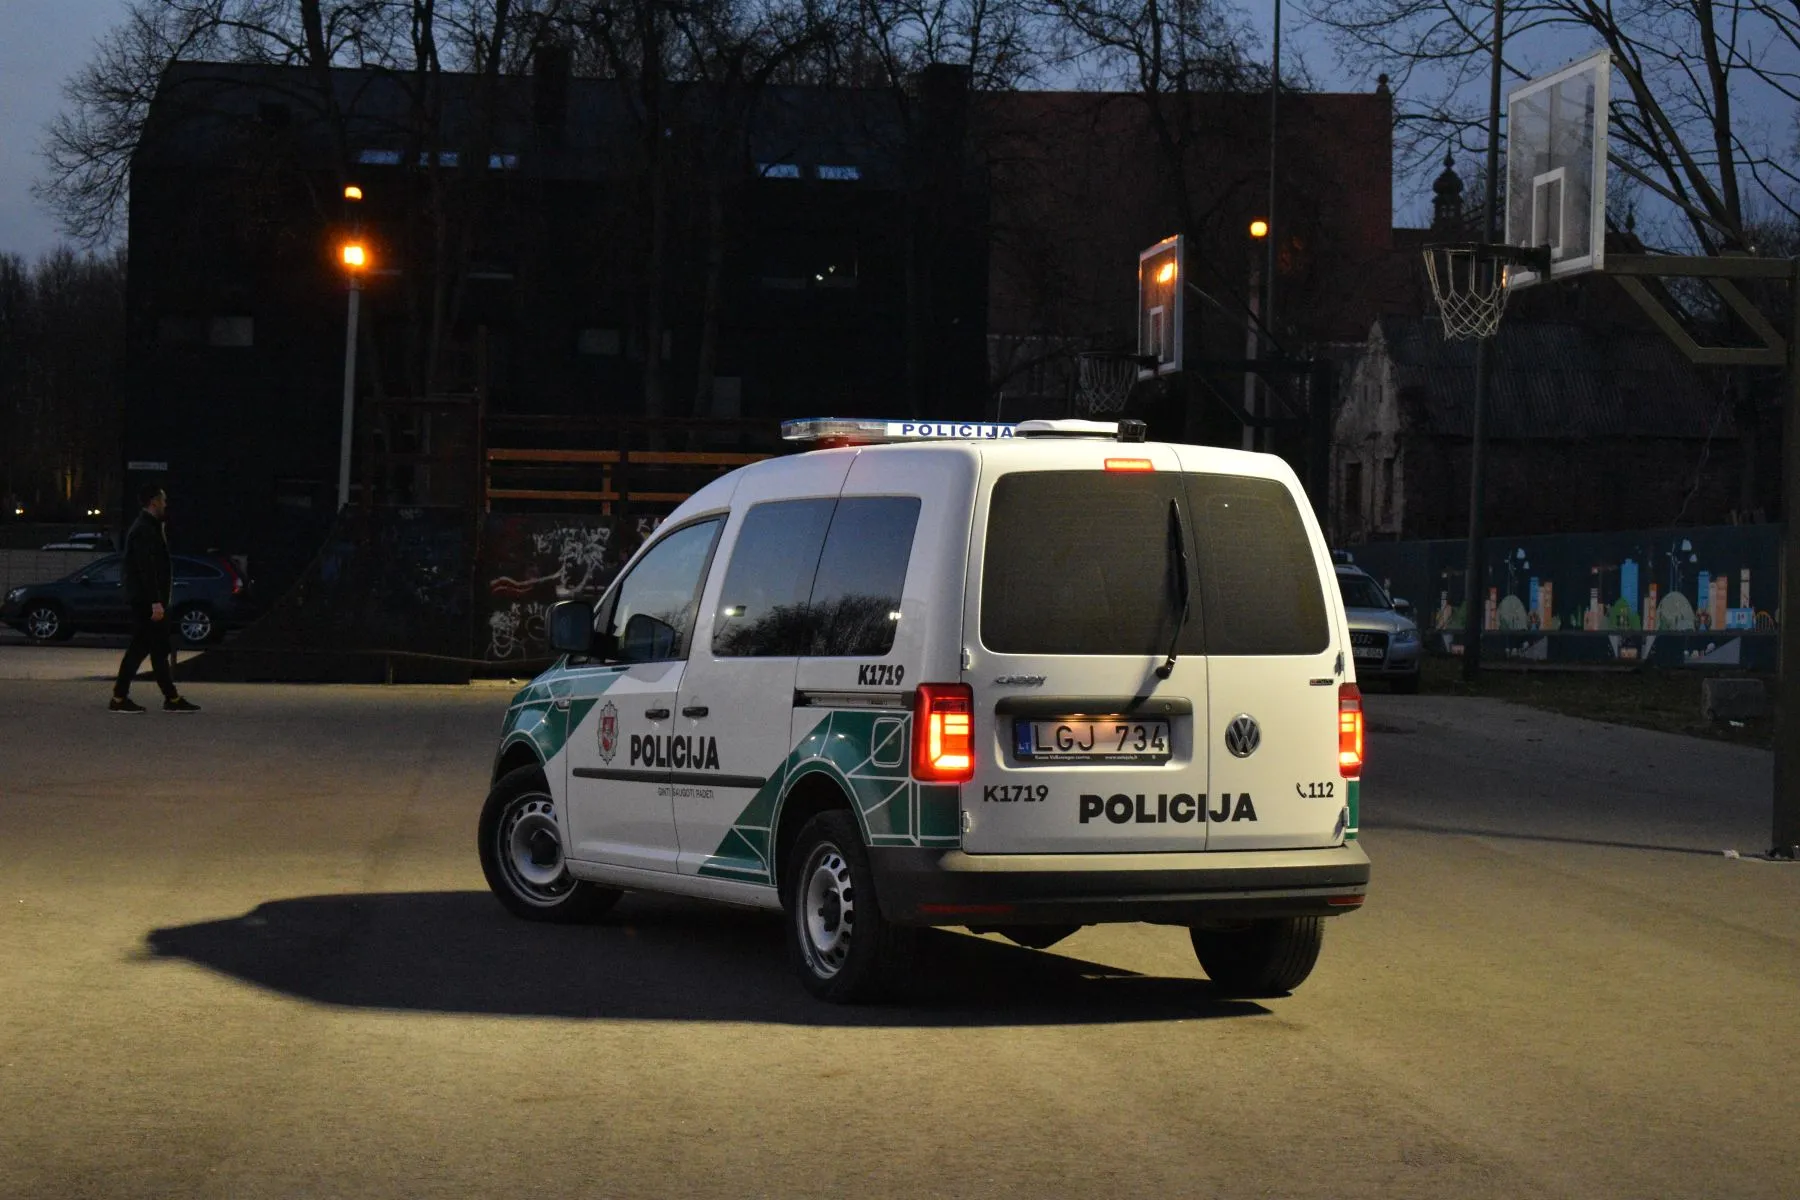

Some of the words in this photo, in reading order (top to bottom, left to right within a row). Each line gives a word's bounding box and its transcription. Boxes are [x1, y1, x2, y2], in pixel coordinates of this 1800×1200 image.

[901, 423, 1013, 438] POLICIJA
[857, 665, 905, 686] K1719
[1018, 742, 1030, 751] LT
[1034, 725, 1095, 751] LGJ
[1115, 725, 1165, 751] 734
[630, 734, 720, 770] POLICIJA
[983, 784, 1049, 803] K1719
[1308, 782, 1334, 798] 112
[1078, 793, 1258, 825] POLICIJA
